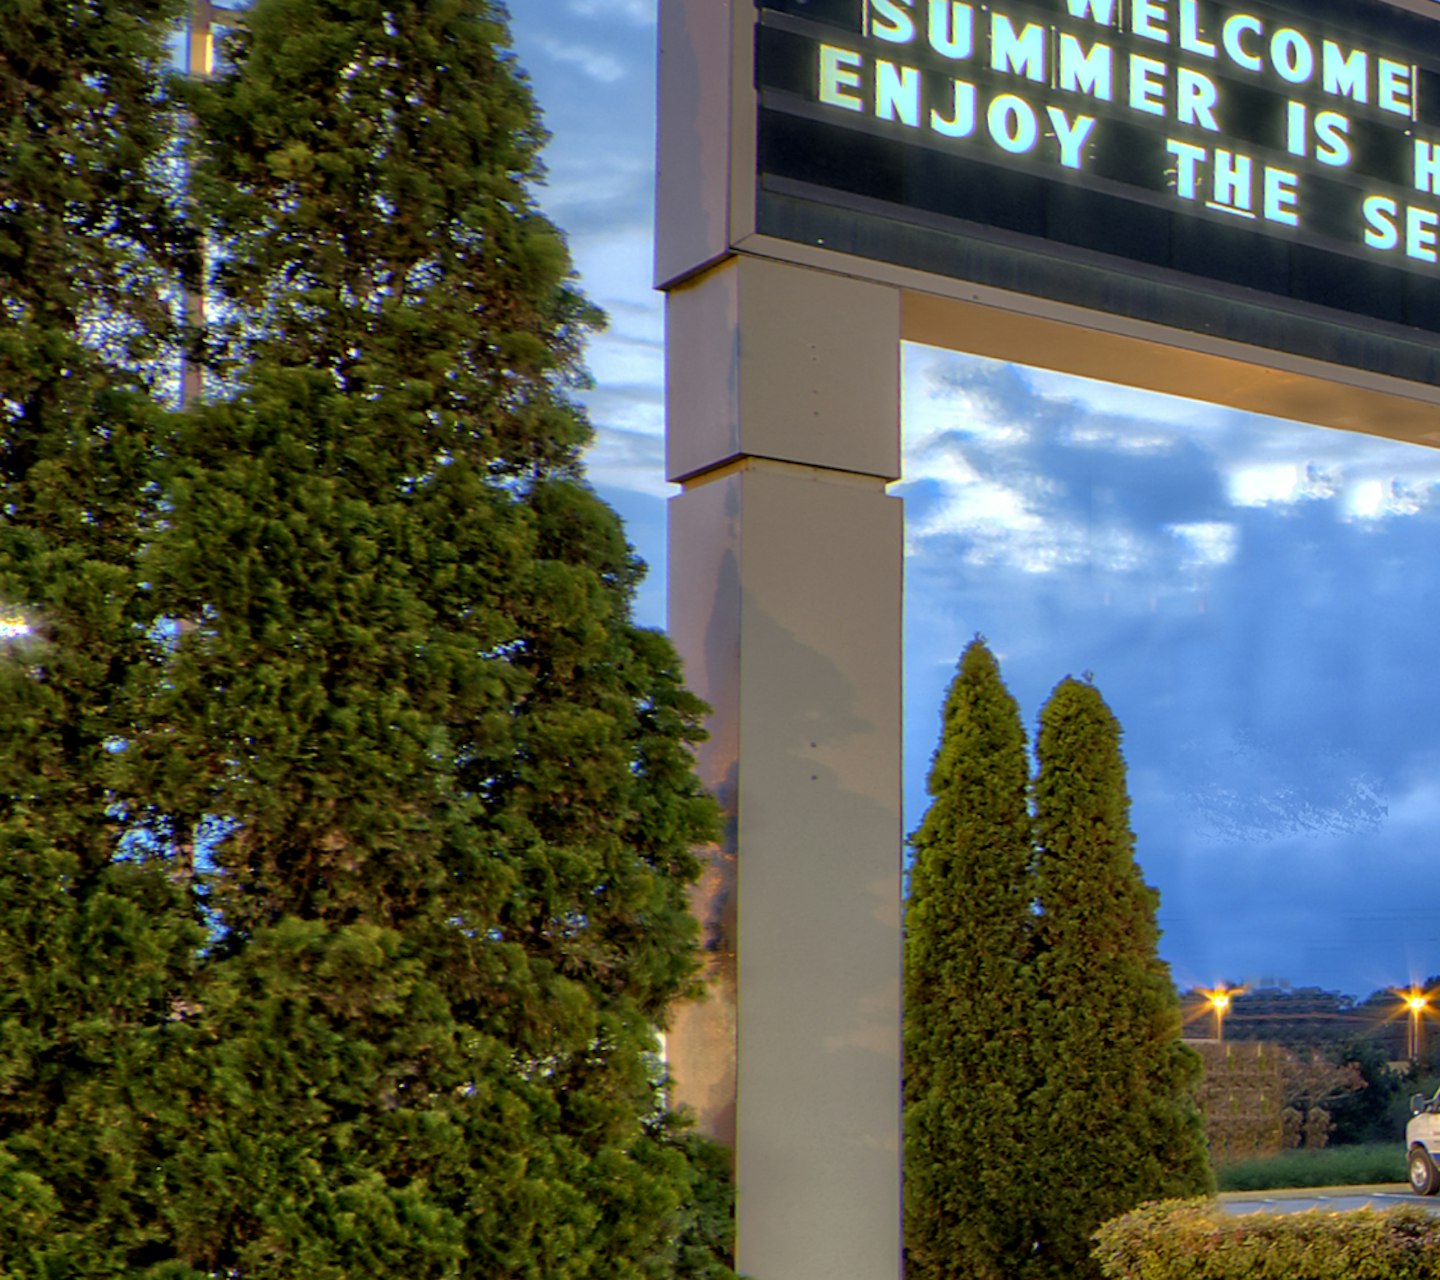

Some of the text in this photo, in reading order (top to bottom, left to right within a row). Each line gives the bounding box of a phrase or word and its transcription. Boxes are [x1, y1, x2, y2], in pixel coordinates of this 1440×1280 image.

[819, 44, 1095, 168] ENJOY
[1166, 139, 1300, 226] THE
[1287, 100, 1350, 166] IS
